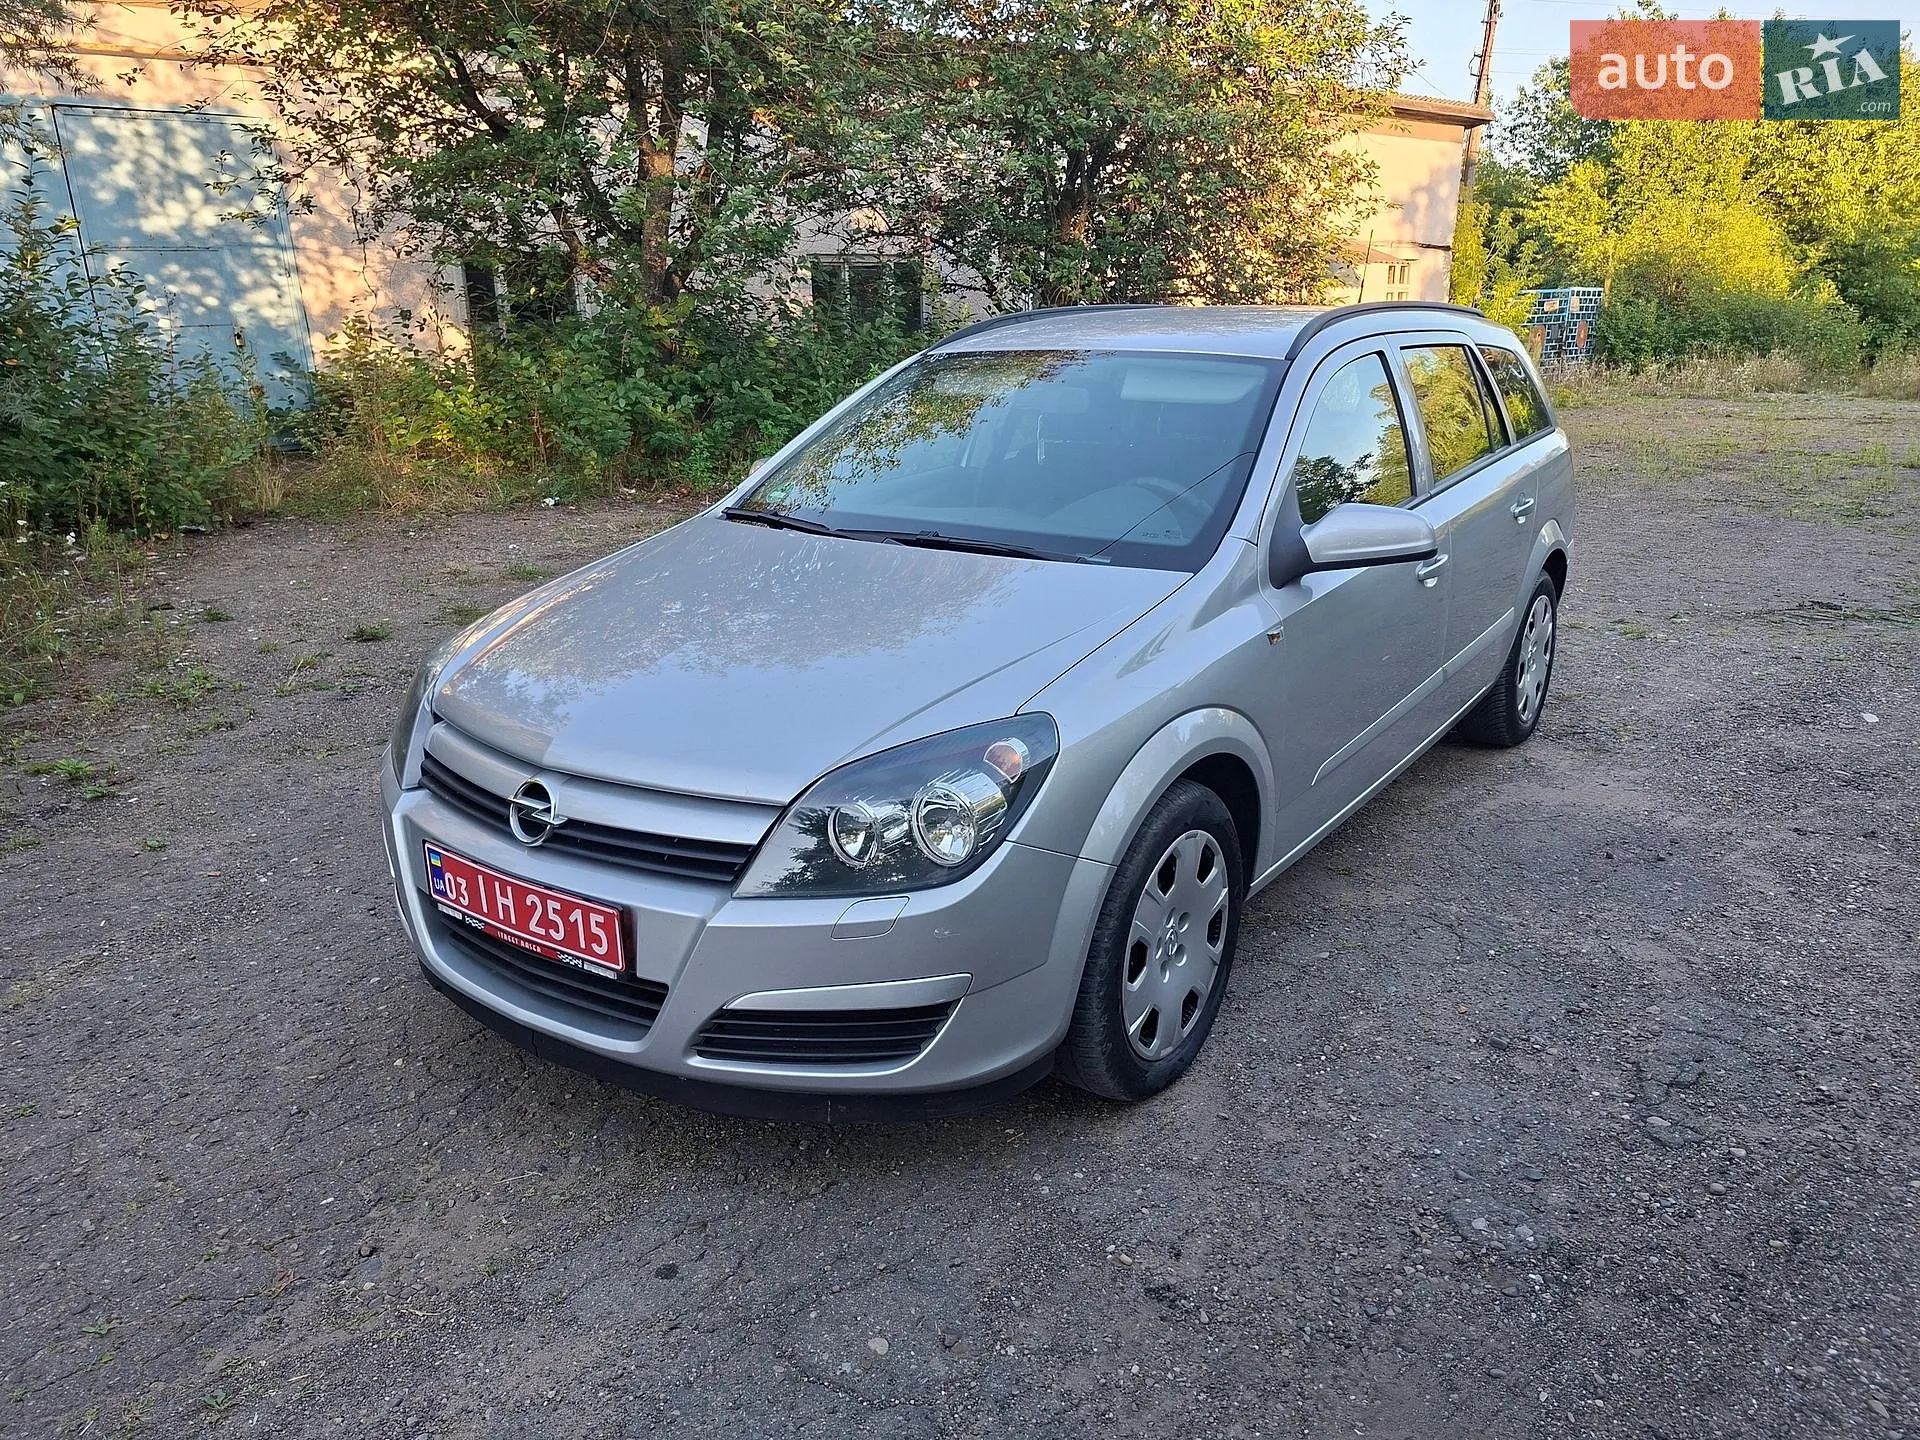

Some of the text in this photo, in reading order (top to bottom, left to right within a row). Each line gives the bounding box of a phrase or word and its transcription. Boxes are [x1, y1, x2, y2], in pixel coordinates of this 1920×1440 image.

[433, 876, 446, 892] UA
[444, 872, 469, 906] 03
[525, 893, 609, 956] 2515
